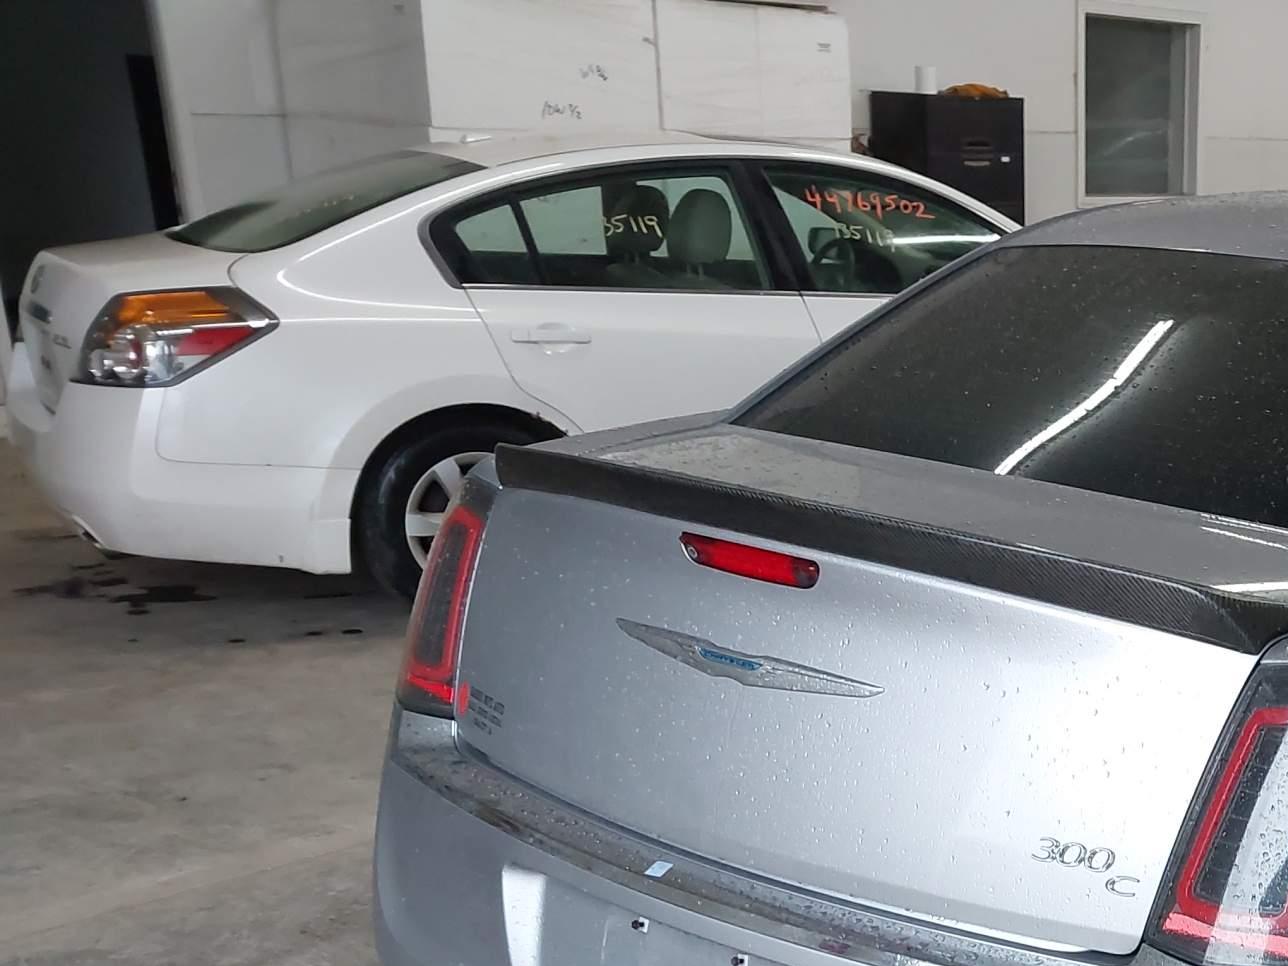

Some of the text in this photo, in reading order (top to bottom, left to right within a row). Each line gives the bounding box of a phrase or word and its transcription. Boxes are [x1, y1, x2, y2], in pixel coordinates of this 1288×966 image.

[805, 184, 937, 218] 44769502
[1032, 836, 1140, 898] 300 C
